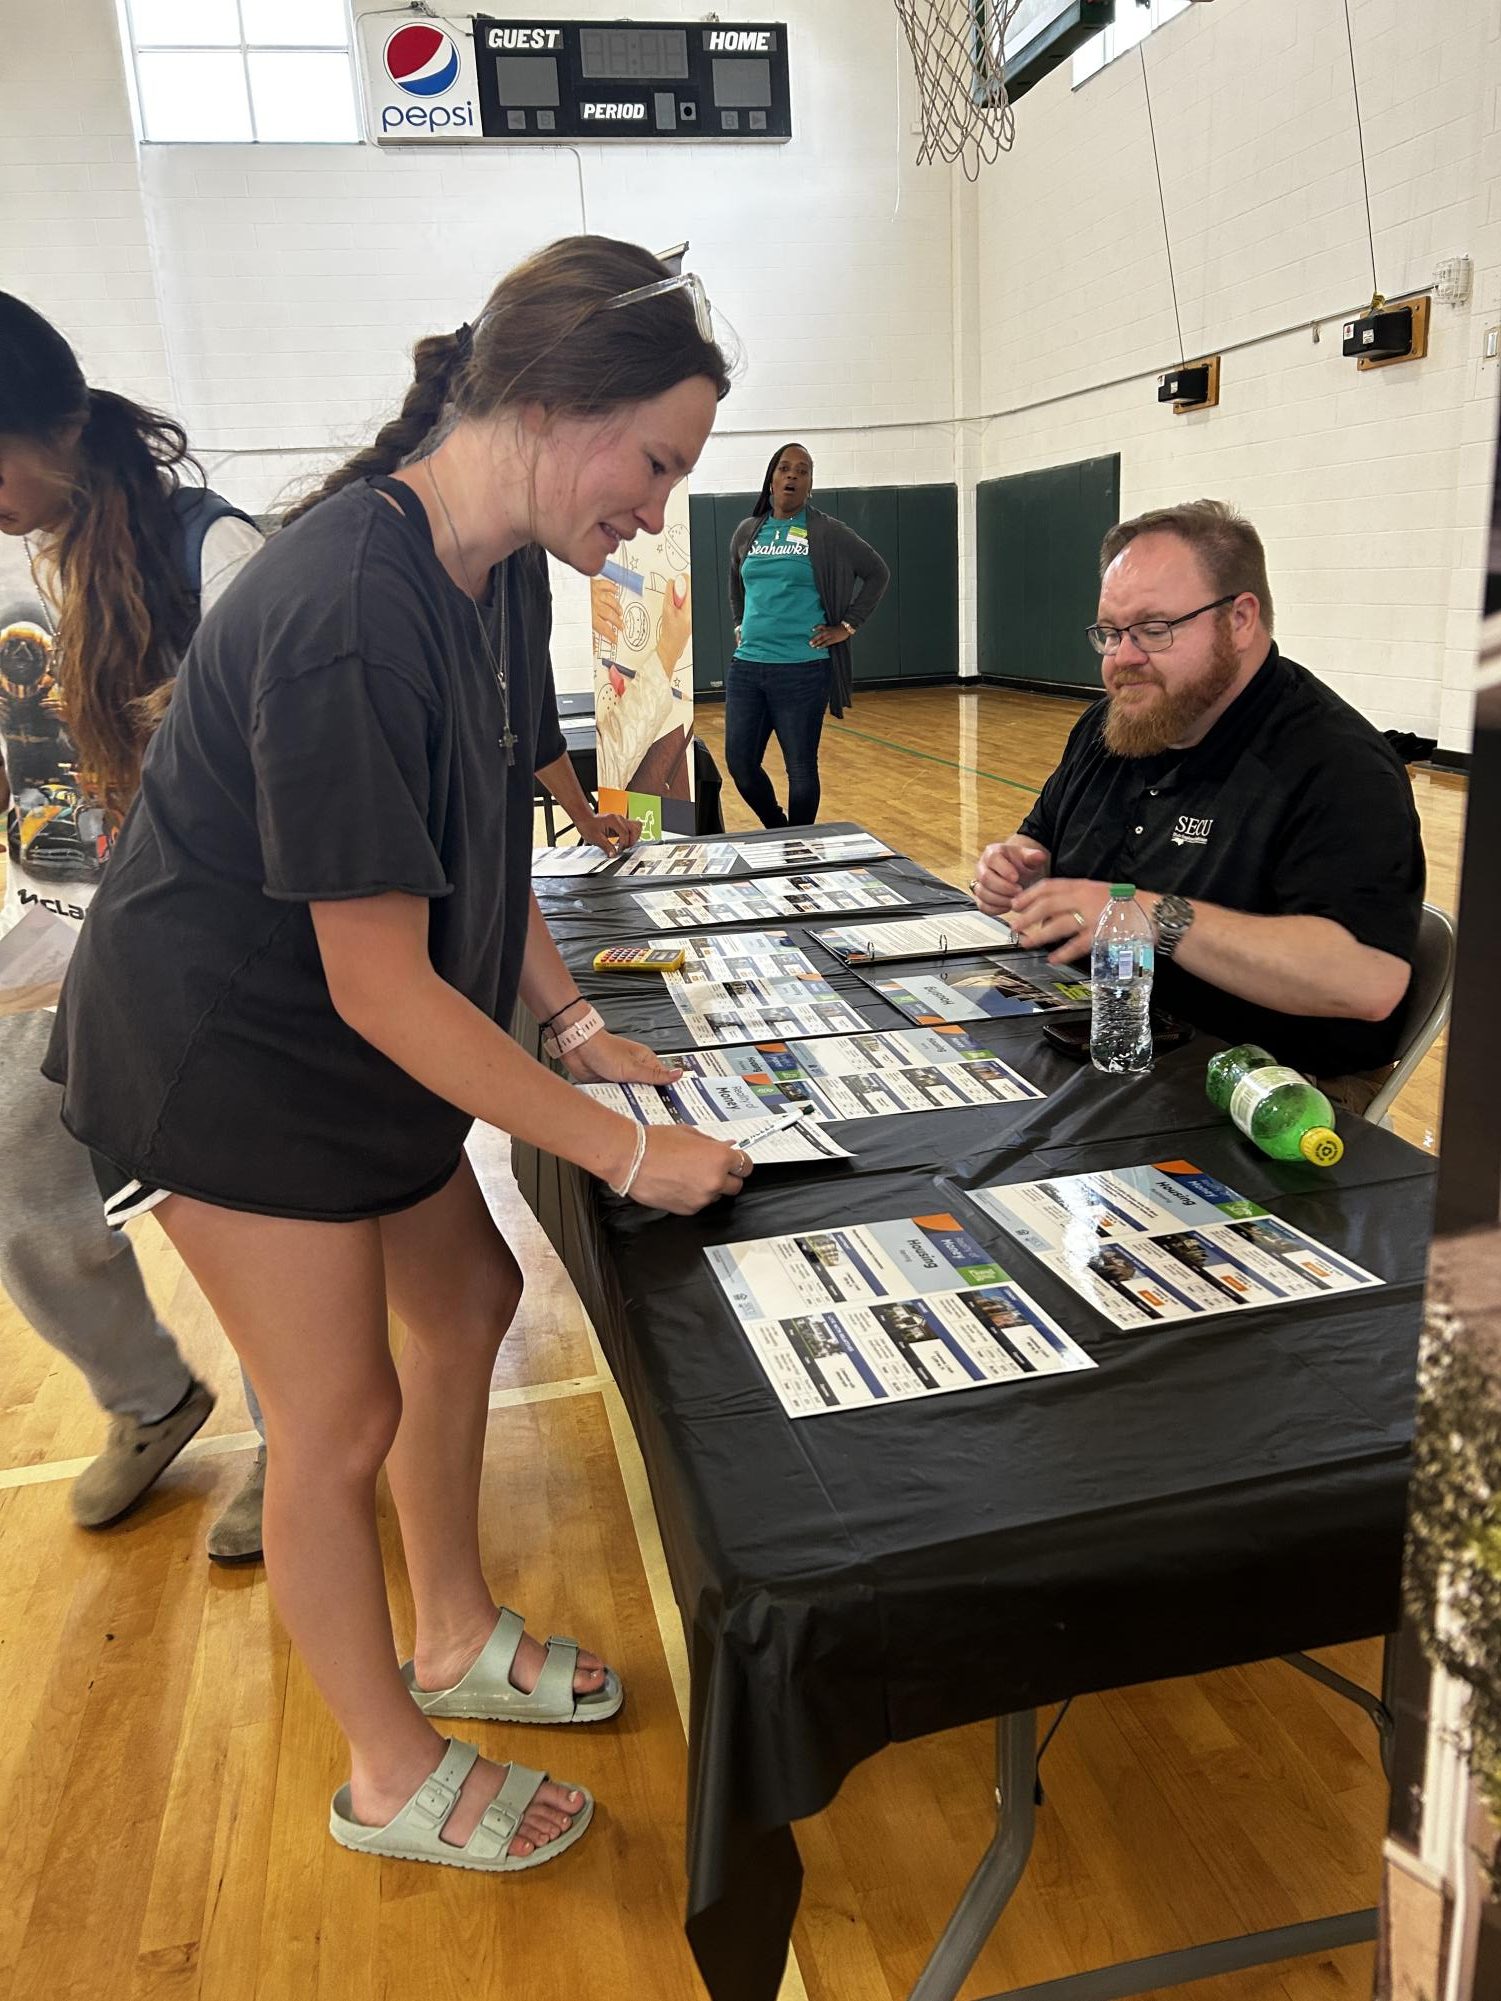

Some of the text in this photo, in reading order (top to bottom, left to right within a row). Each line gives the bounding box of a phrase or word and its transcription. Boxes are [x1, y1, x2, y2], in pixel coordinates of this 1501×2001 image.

[488, 28, 560, 49] GUEST
[709, 31, 771, 51] HOME
[382, 101, 473, 132] pepsi
[583, 103, 645, 119] PERIOD
[747, 540, 809, 556] Seahawks
[1175, 815, 1214, 837] SECU
[715, 1087, 741, 1110] Money
[1156, 1181, 1197, 1206] Housing
[906, 1238, 939, 1269] Housing
[940, 1238, 967, 1259] Money
